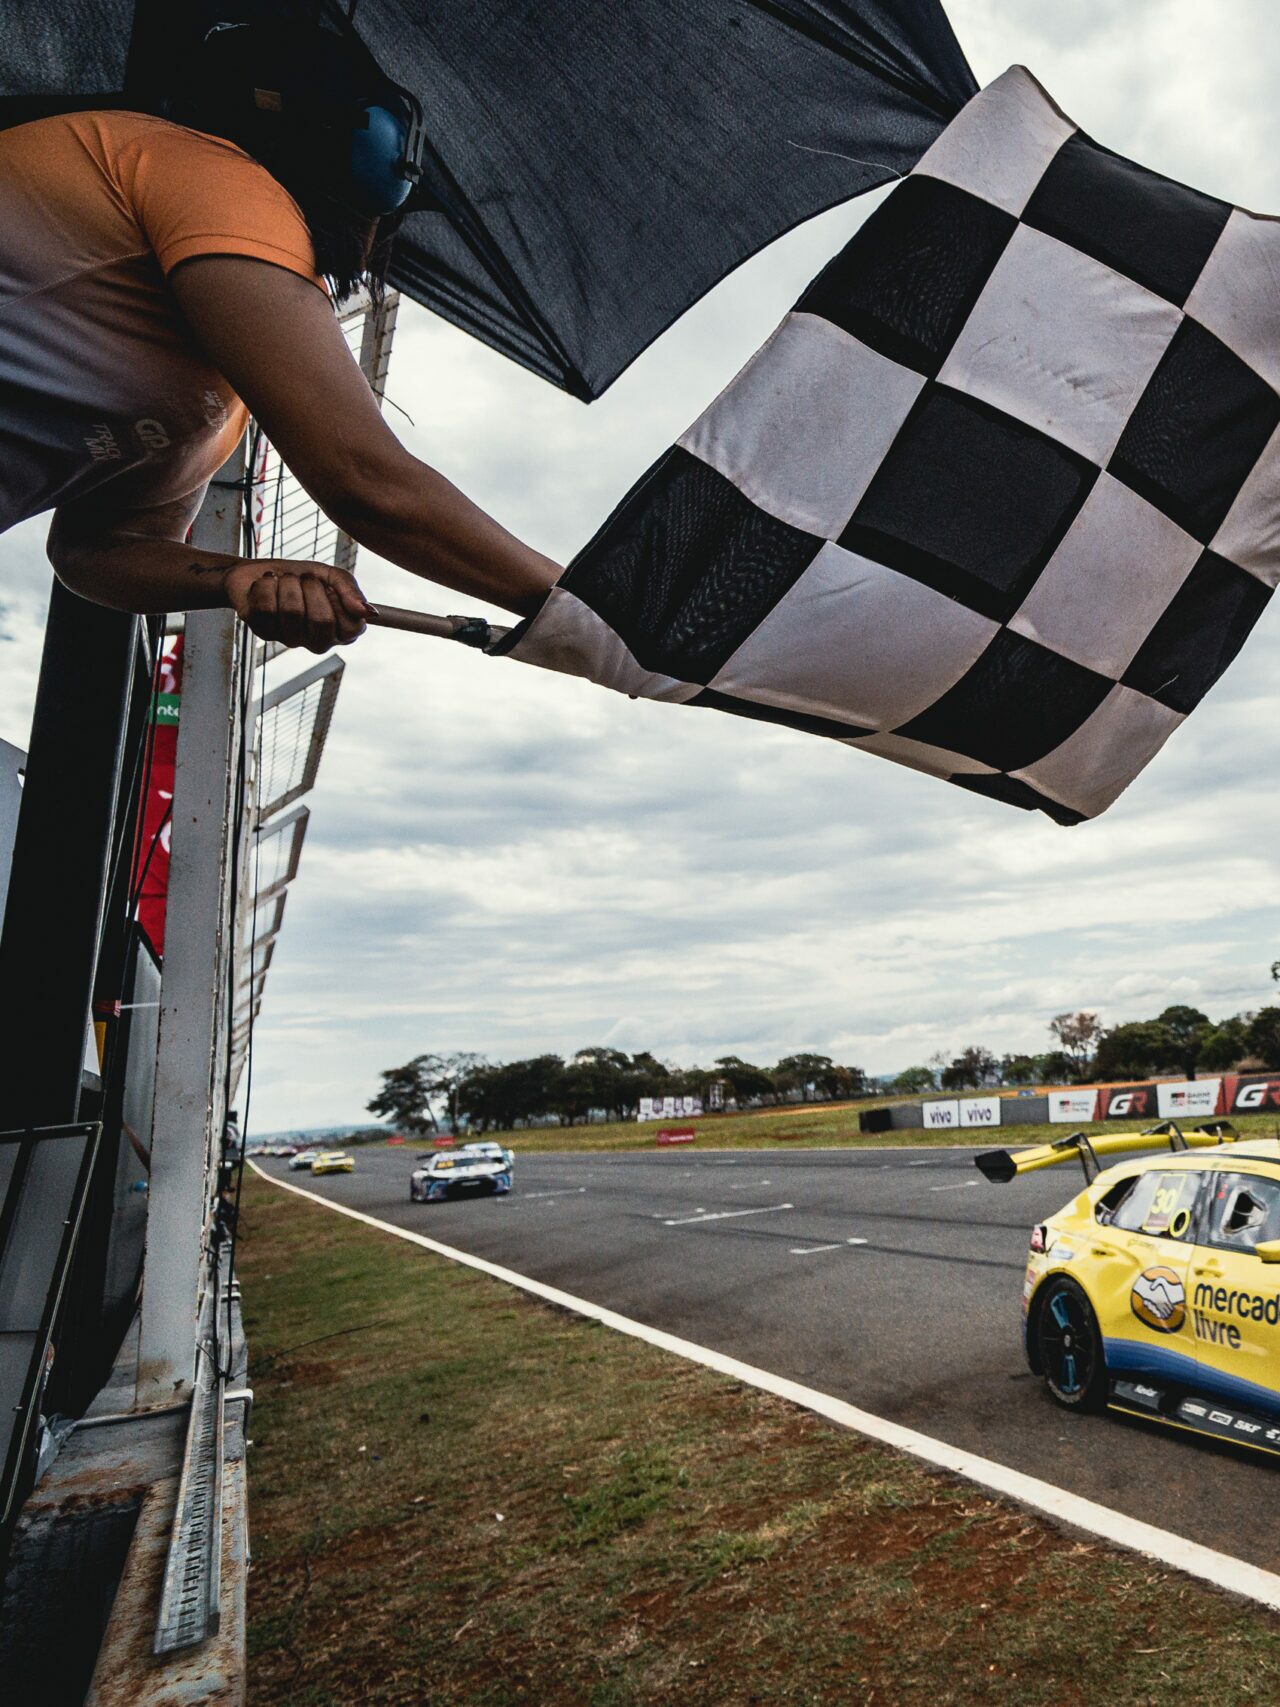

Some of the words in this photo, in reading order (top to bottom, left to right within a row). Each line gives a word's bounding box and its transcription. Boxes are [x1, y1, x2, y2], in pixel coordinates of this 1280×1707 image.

[967, 1105, 992, 1123] vivo
[1108, 1091, 1148, 1115] GR
[929, 1108, 953, 1125] vivo
[1151, 1188, 1177, 1215] 30
[1194, 1314, 1241, 1349] livre
